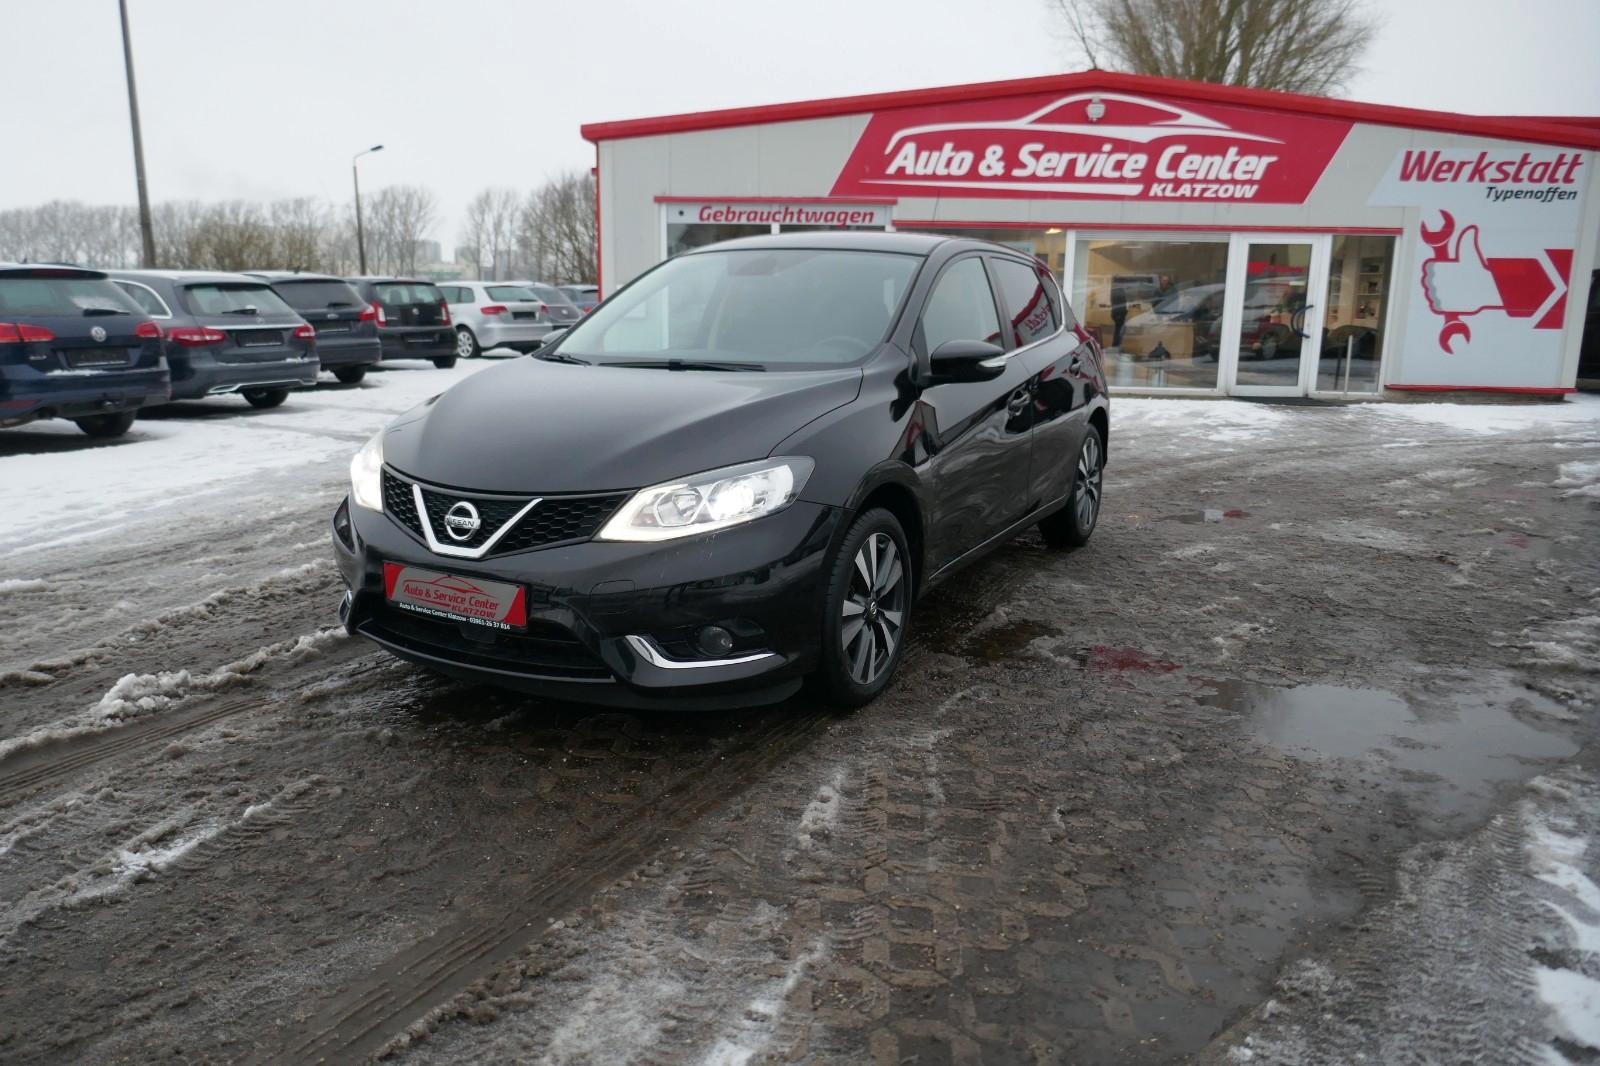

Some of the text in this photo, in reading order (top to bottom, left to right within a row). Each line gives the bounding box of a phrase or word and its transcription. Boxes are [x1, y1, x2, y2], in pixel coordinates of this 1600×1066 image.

[885, 141, 1278, 181] Auto & Service Center
[1399, 150, 1584, 184] Werkstatt
[1149, 183, 1259, 198] KLATZOW
[1486, 186, 1578, 202] Typenoffen
[699, 204, 874, 228] Gebrauchtwagen
[447, 517, 475, 527] NISSAN
[404, 583, 424, 596] Auto
[433, 590, 466, 604] Service
[469, 596, 499, 610] Center
[451, 604, 496, 619] KLATZOW
